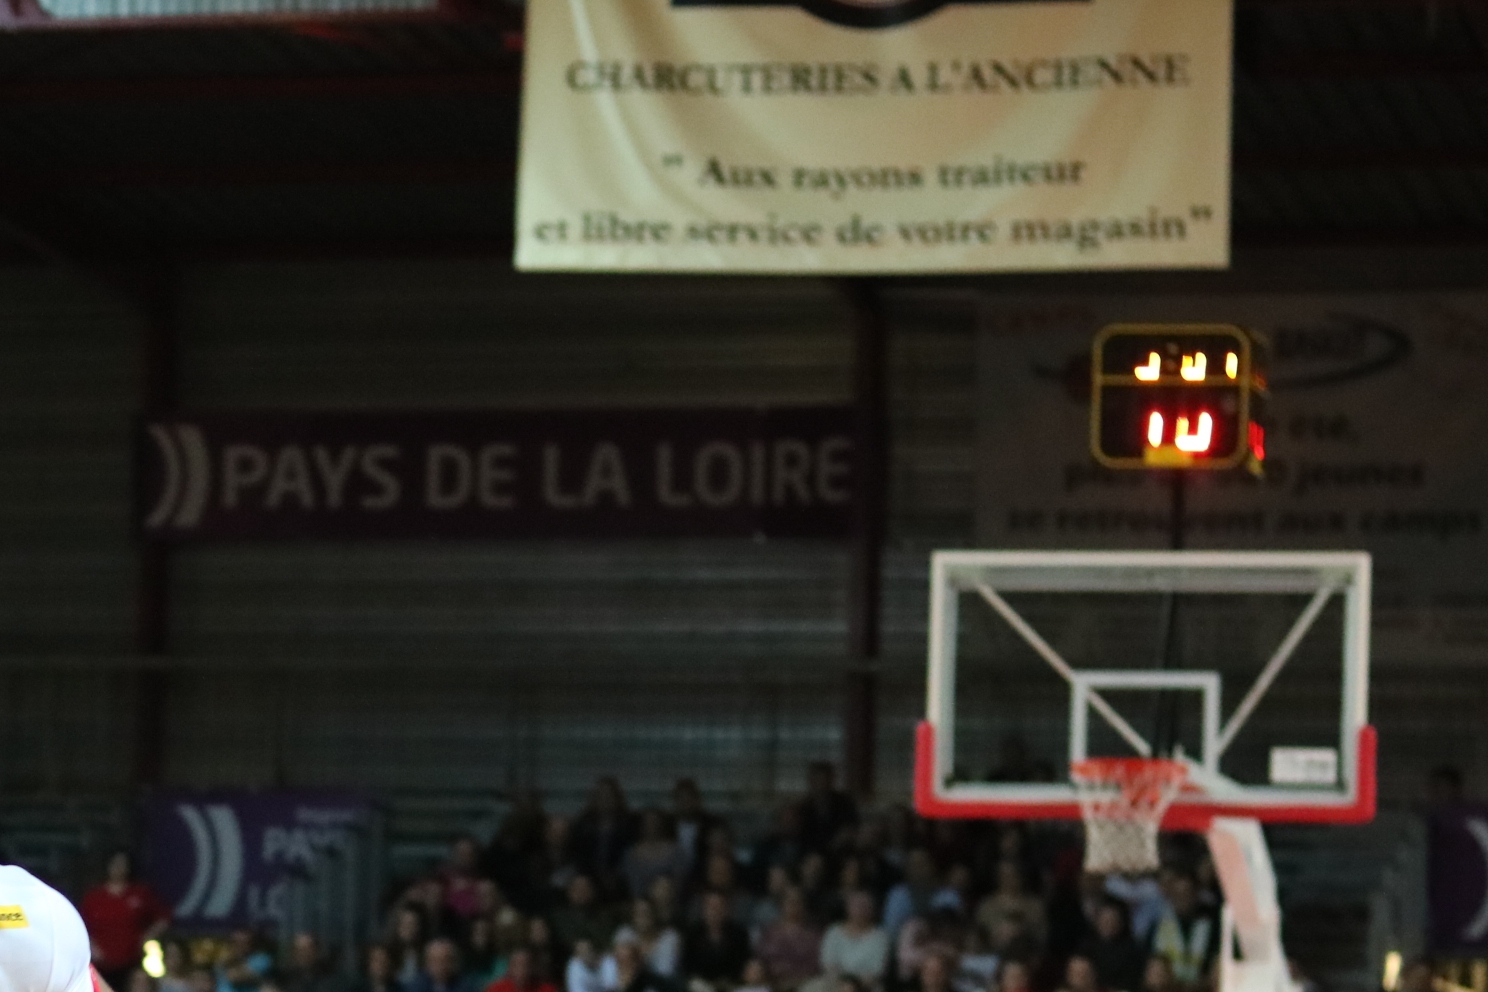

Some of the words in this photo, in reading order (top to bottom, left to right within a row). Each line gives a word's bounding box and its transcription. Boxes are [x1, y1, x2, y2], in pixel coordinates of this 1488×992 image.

[566, 58, 878, 96] CHARCUTERIES
[894, 61, 916, 94] A
[926, 53, 1190, 93] L'ANCIENNE
[698, 156, 776, 189] Aux
[790, 161, 923, 199] rayons
[937, 156, 1087, 186] traiteur
[532, 218, 570, 245] et
[580, 213, 671, 245] libre
[683, 216, 823, 247] service
[835, 214, 883, 247] de
[896, 217, 995, 246] votre
[221, 444, 401, 511] PAYS
[425, 442, 518, 510] DE
[542, 441, 633, 508] LA
[654, 437, 854, 507] LOIRE
